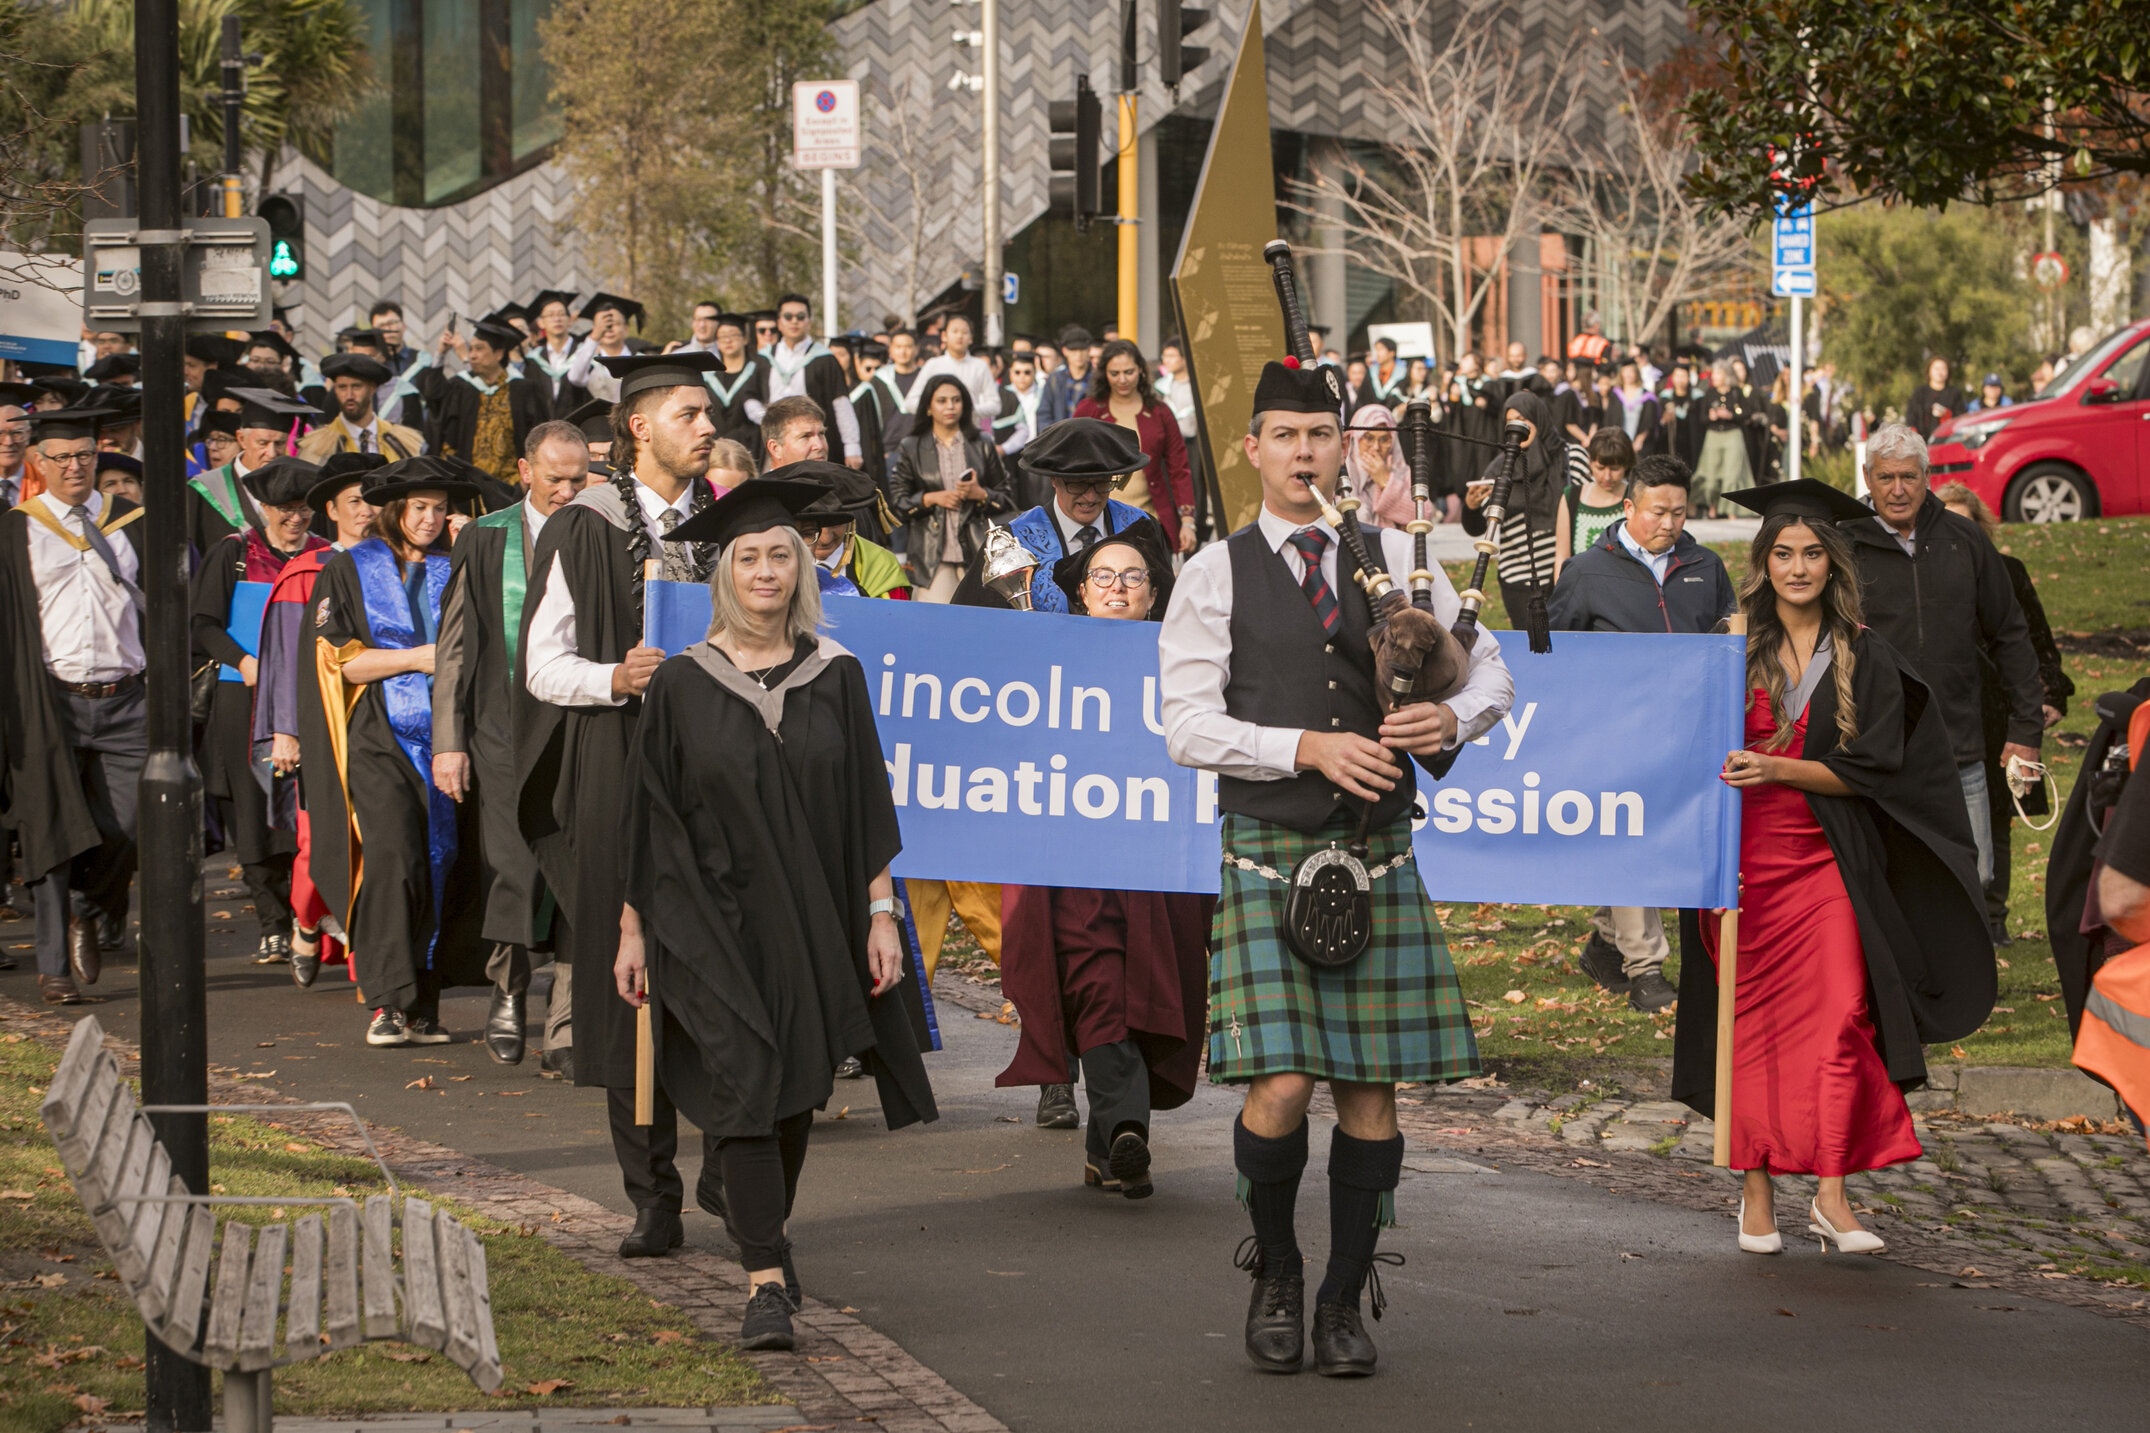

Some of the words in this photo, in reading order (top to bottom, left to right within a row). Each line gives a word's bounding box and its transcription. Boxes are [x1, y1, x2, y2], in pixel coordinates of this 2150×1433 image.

[803, 152, 851, 162] BEGINS
[1779, 233, 1810, 249] SHARED
[1782, 249, 1806, 265] ZONE
[879, 653, 1111, 732] incoln
[884, 743, 1170, 822] duation
